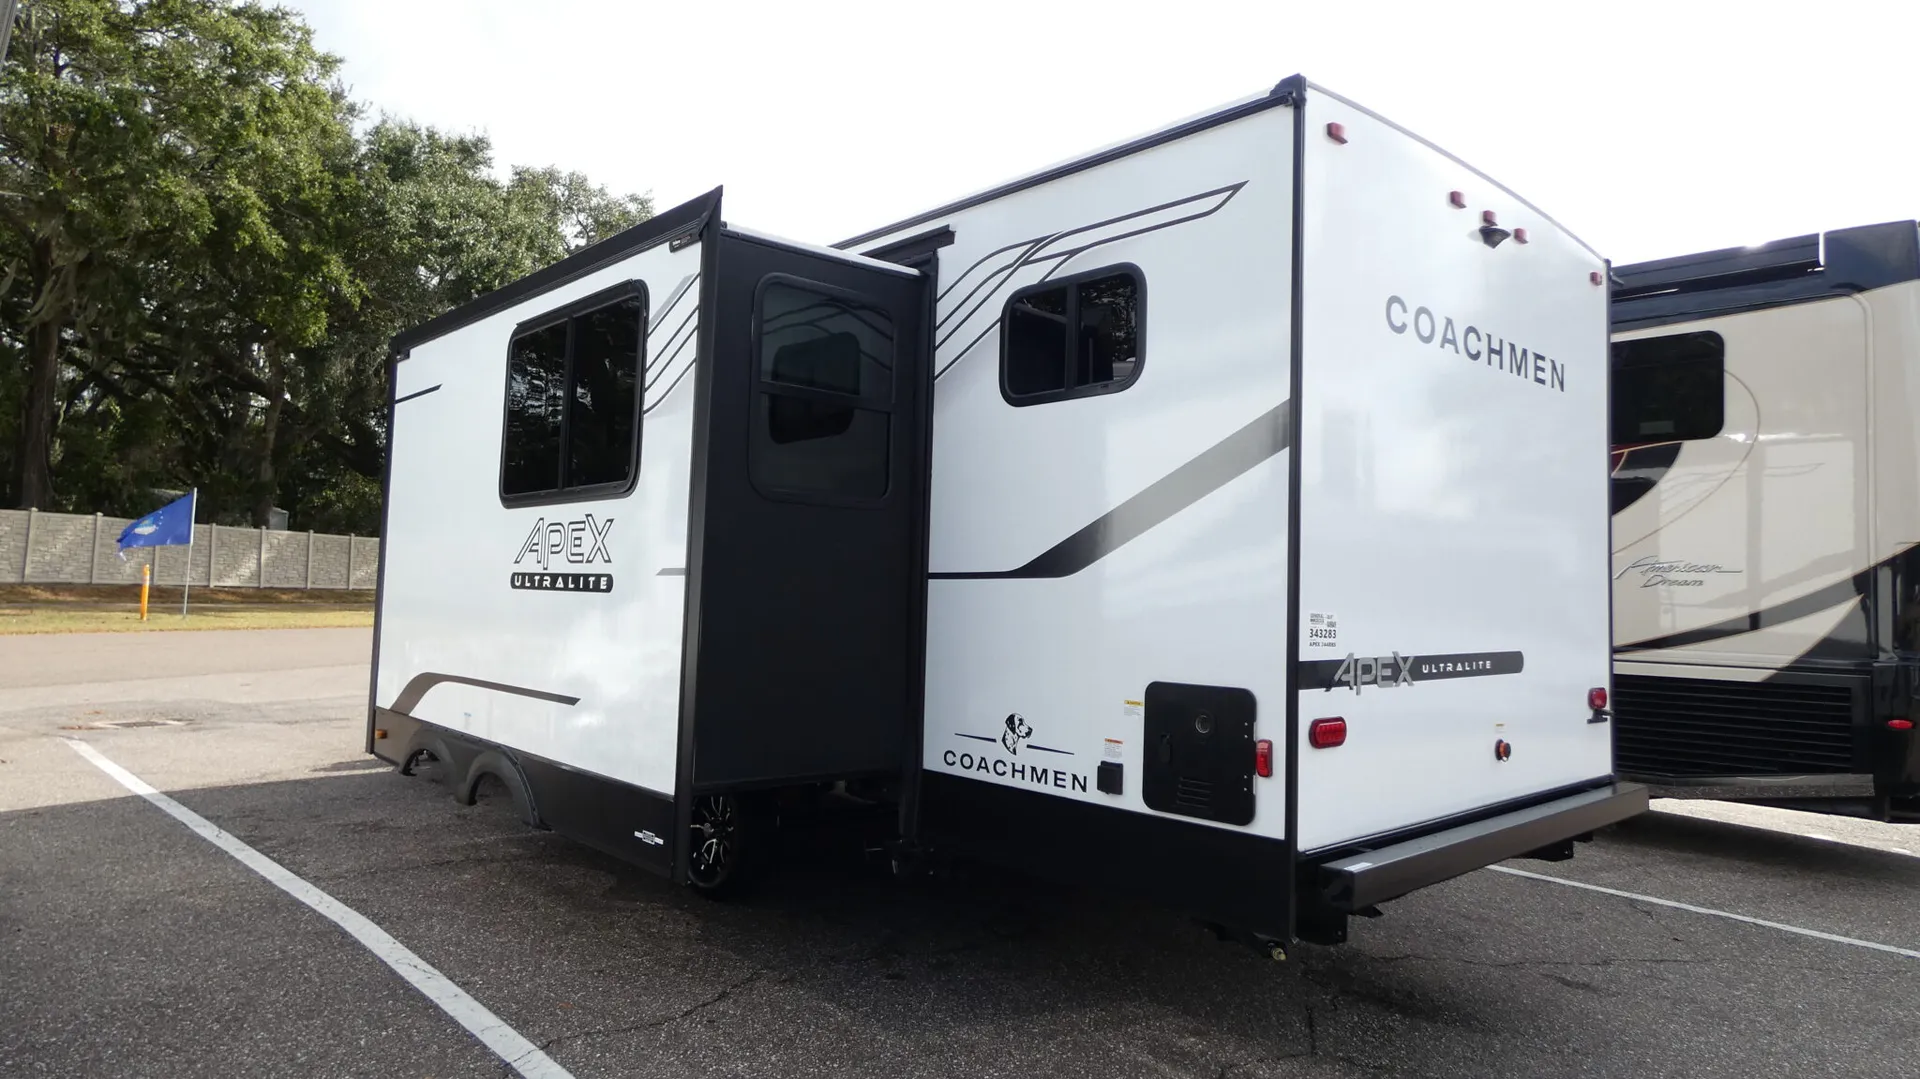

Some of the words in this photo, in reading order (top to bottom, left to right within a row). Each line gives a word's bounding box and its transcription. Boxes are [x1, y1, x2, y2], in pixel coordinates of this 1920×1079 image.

[1385, 295, 1565, 393] COACHMEN
[513, 513, 615, 570] APEX
[514, 575, 608, 590] ULTRALITE
[1612, 555, 1743, 580] American
[1640, 574, 1704, 588] Dream
[1309, 628, 1337, 639] 343283
[1325, 651, 1415, 696] APEX
[1421, 660, 1492, 674] ULTRALITE
[943, 750, 1088, 793] COACHMEN
